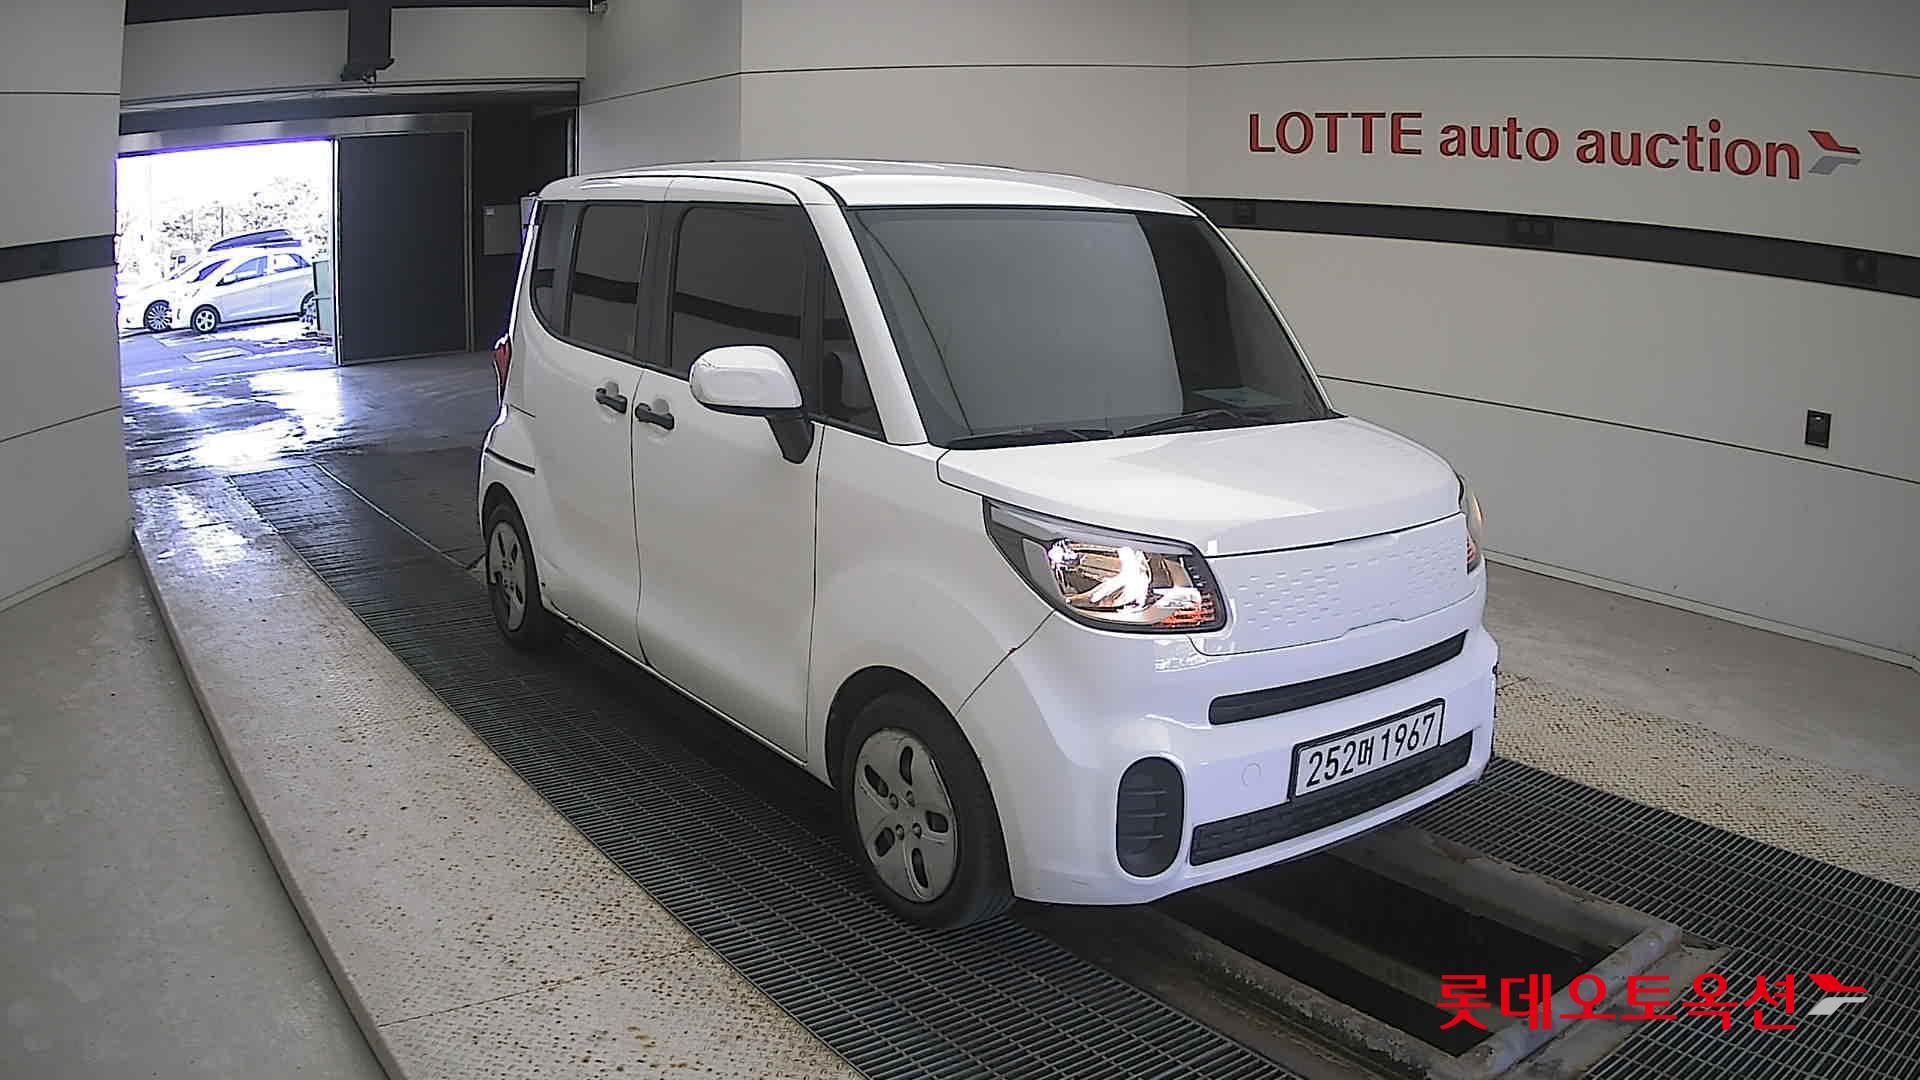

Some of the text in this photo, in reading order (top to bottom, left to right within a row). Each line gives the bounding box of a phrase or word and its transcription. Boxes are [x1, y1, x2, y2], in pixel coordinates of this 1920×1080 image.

[1249, 111, 1801, 180] LOTTE auto auction
[1380, 712, 1436, 761] 1967
